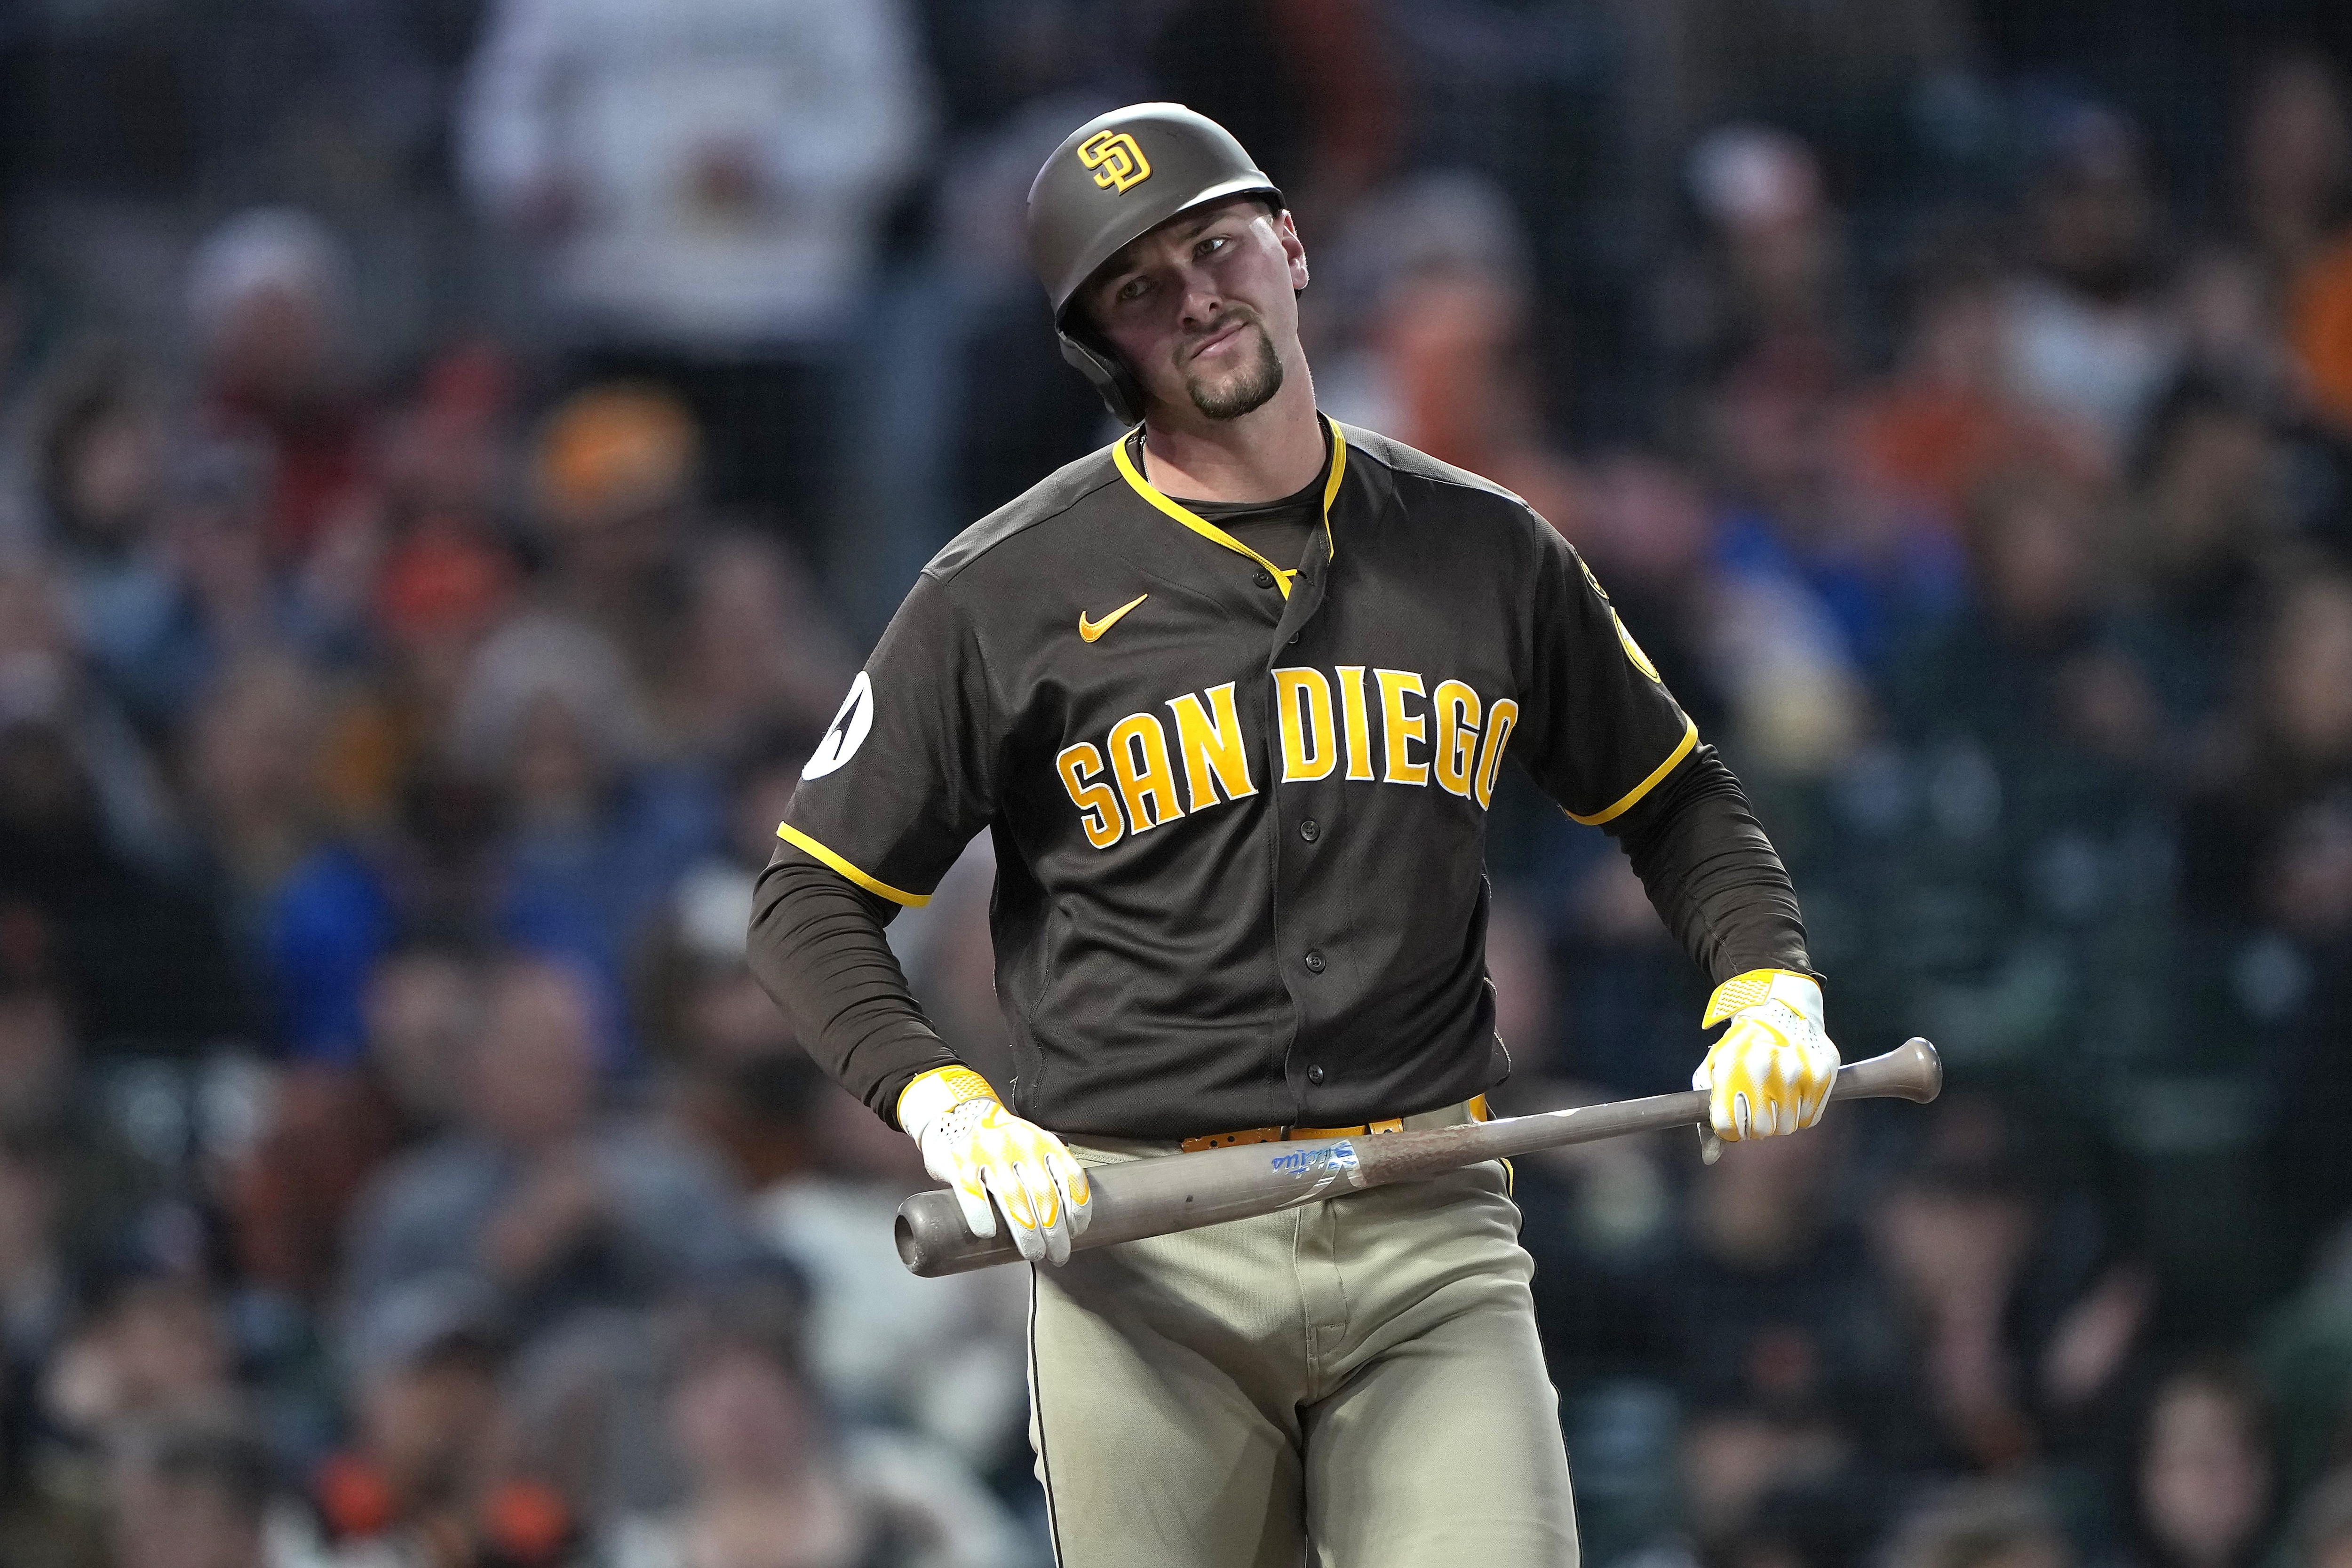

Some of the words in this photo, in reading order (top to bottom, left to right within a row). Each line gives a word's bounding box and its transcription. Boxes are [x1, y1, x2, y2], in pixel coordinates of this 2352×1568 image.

[1077, 129, 1152, 195] SD
[1056, 681, 1259, 850] SAN
[1271, 665, 1518, 811] DIEGO
